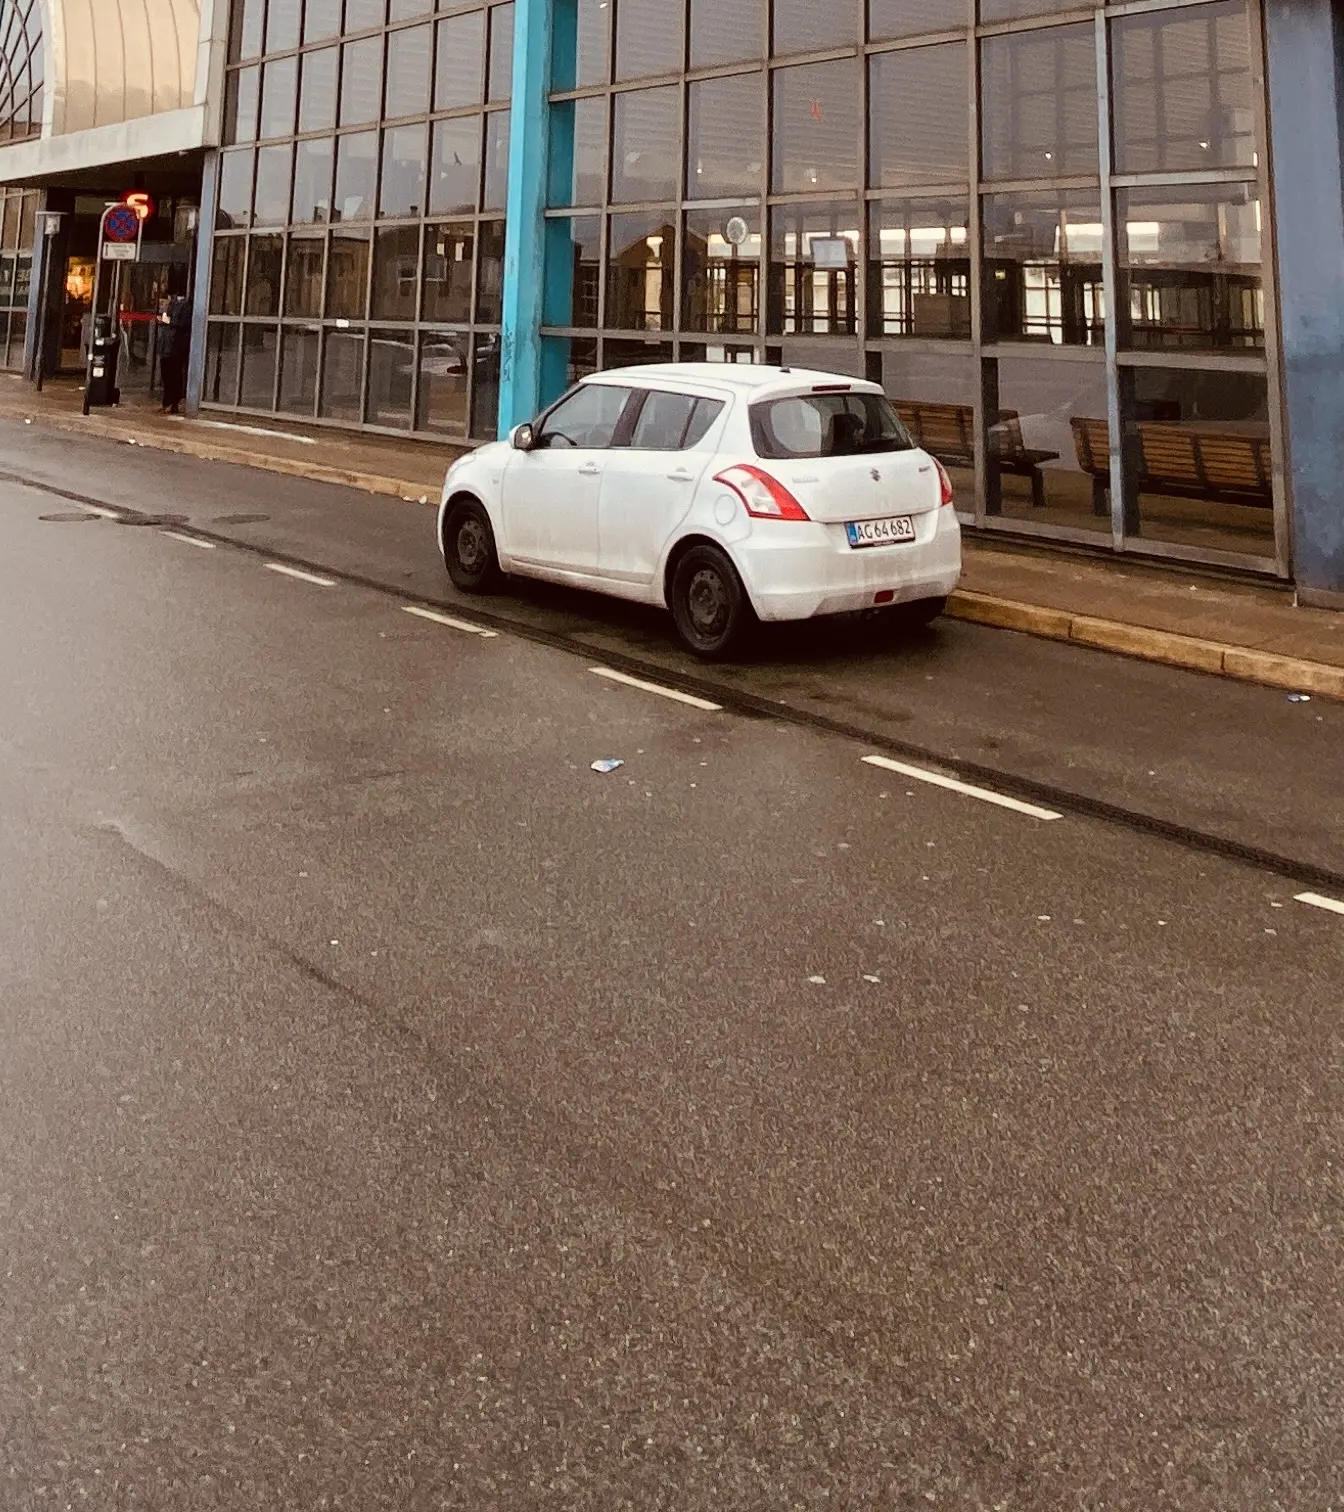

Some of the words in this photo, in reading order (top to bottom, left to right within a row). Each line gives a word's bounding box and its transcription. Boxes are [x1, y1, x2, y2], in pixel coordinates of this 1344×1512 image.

[858, 524, 873, 539] AG
[874, 522, 889, 537] 64
[891, 519, 911, 535] 682
